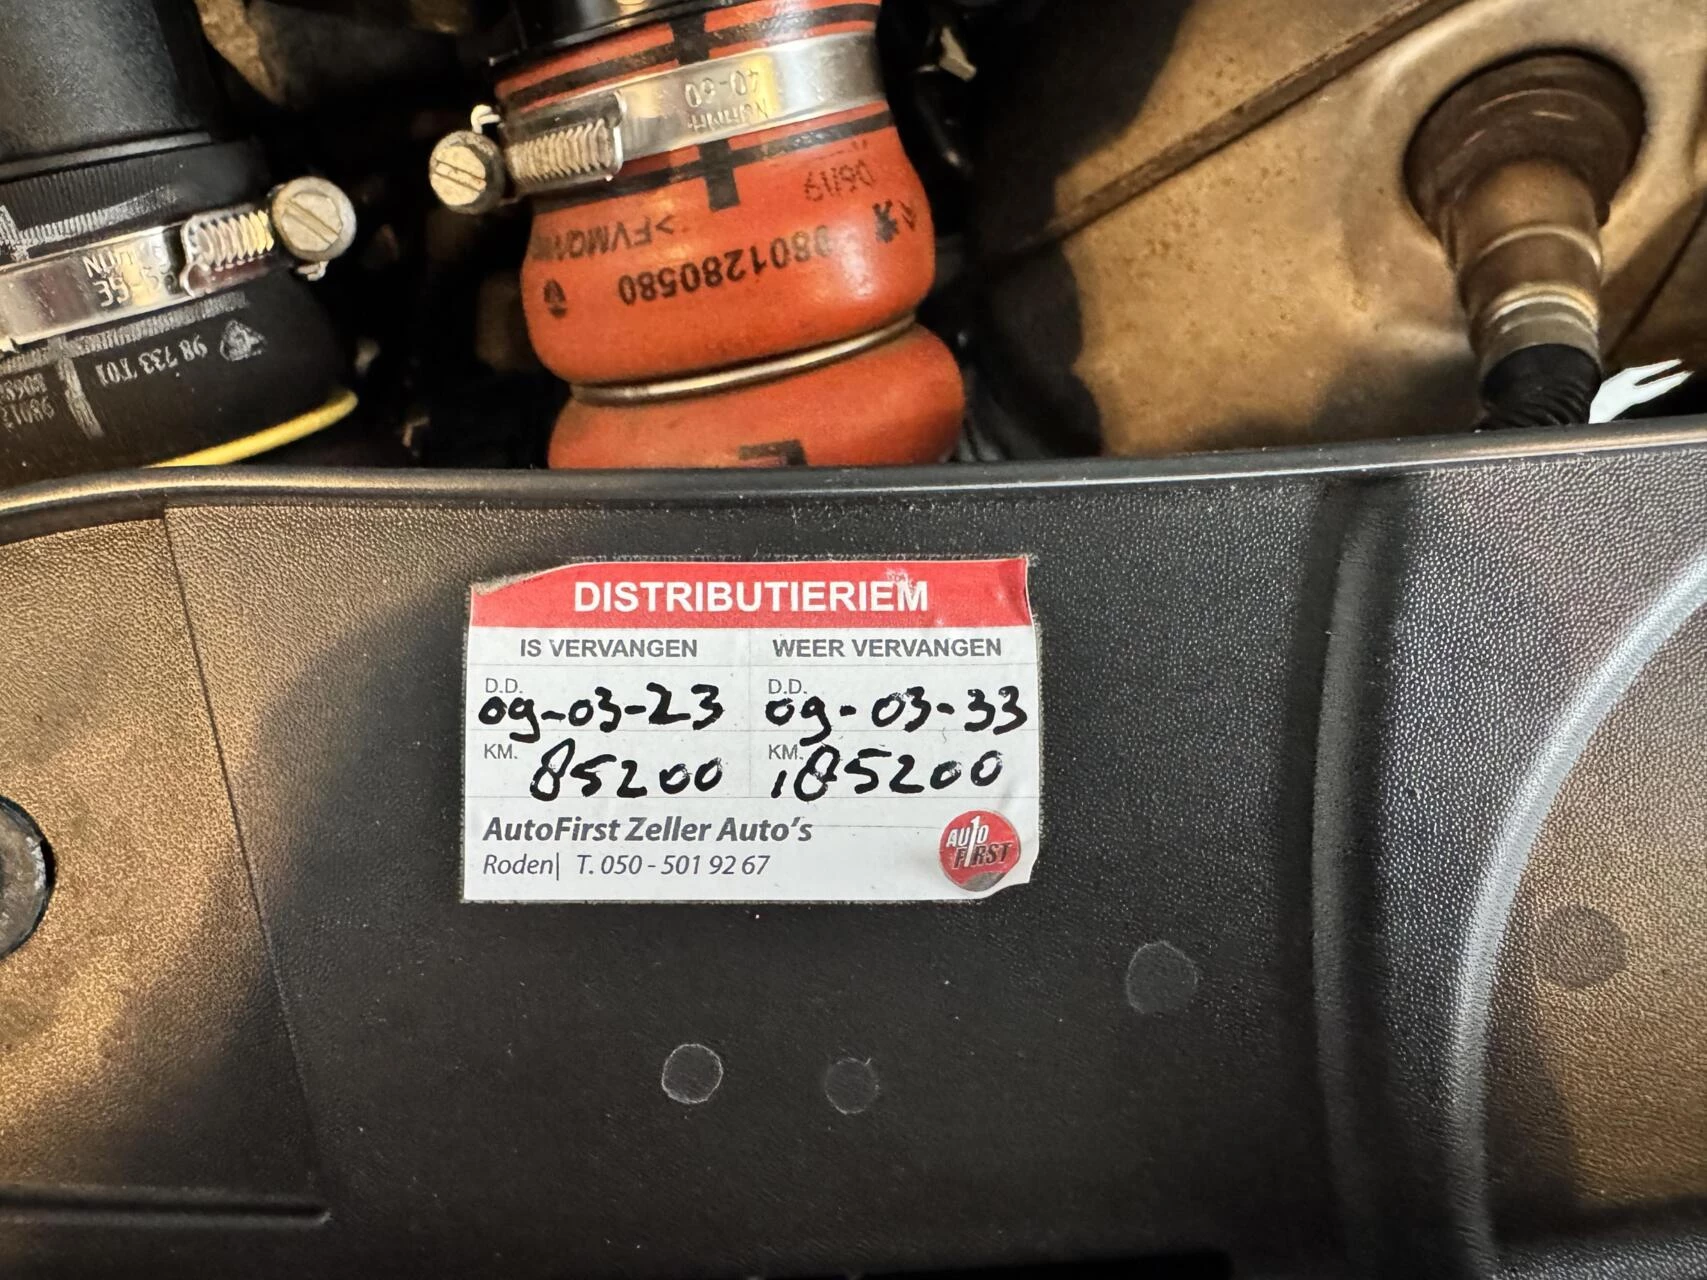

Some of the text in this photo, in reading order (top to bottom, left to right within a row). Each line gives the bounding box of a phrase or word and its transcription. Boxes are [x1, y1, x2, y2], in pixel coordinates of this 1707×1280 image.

[573, 581, 929, 613] DISTRIBUTIERIEM
[520, 638, 698, 658] IS VERVANGEN
[773, 638, 1002, 658] WEER VERVANGEN
[484, 678, 524, 695] D.D.
[768, 678, 808, 695] D.D.
[484, 744, 519, 760] KM.
[768, 744, 804, 760] KM.
[530, 738, 724, 802] 85200
[484, 817, 621, 843] AutoFirst
[627, 817, 711, 843] Zeller
[577, 856, 595, 875] T.
[600, 856, 642, 876] 050
[661, 856, 701, 876] 501
